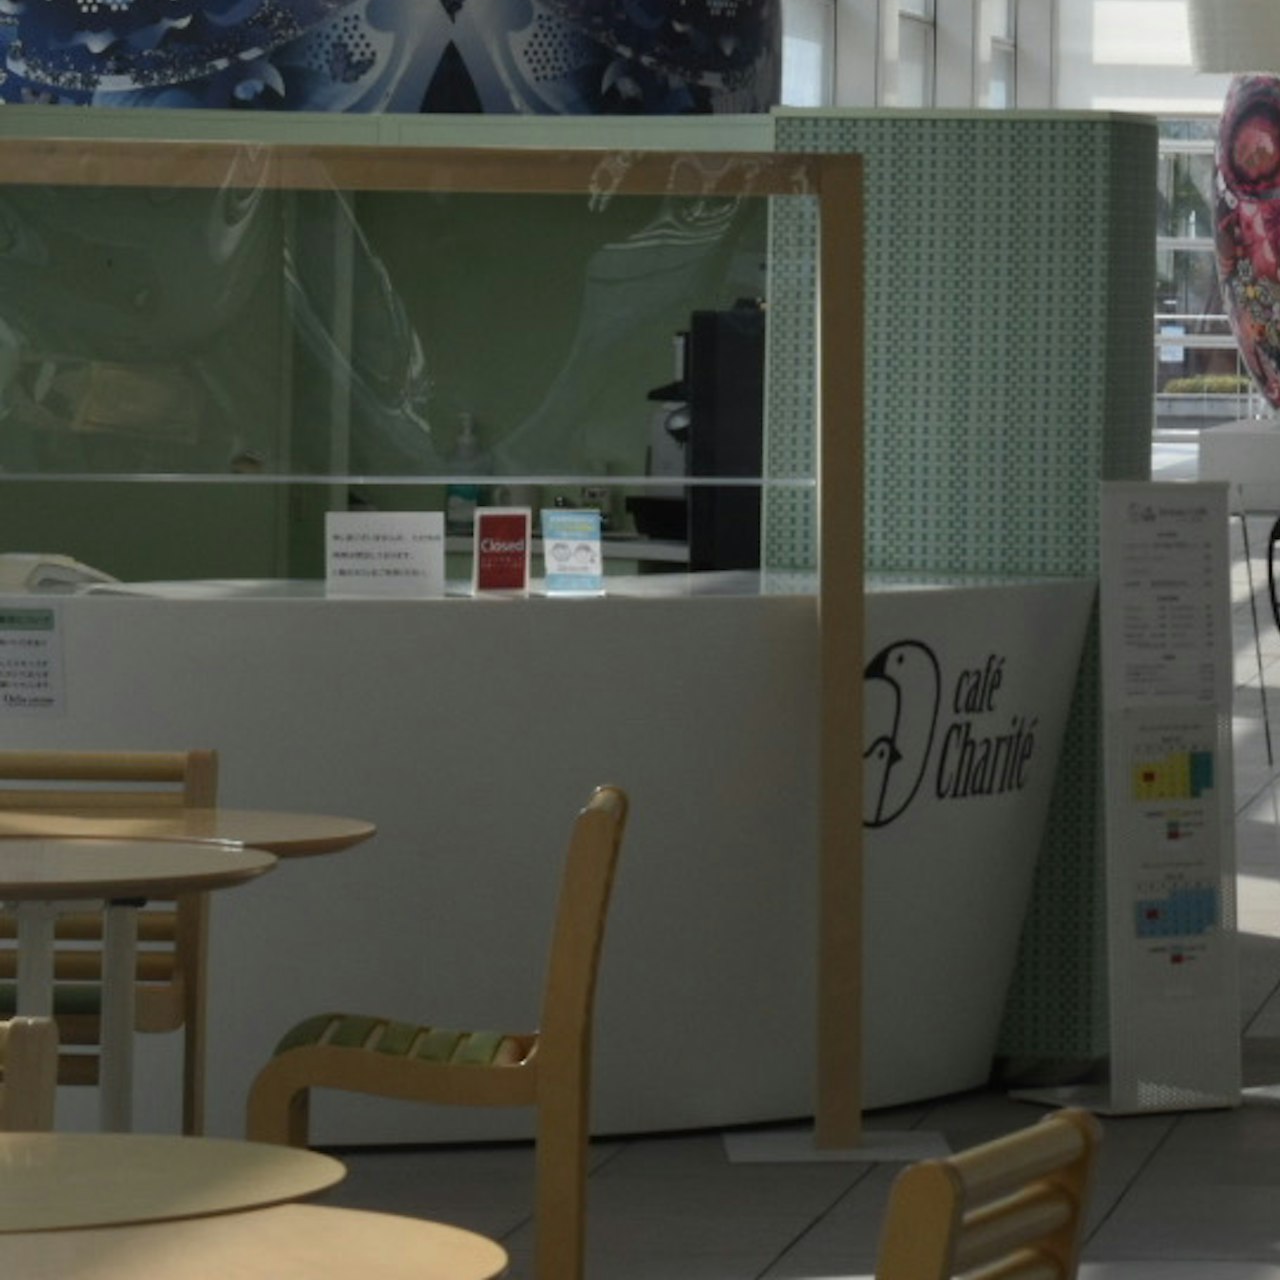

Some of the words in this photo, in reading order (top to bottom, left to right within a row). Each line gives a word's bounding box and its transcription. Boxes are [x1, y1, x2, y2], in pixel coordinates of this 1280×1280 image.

[480, 538, 525, 553] Closed
[953, 653, 1006, 714] café
[936, 716, 1039, 800] Charité
